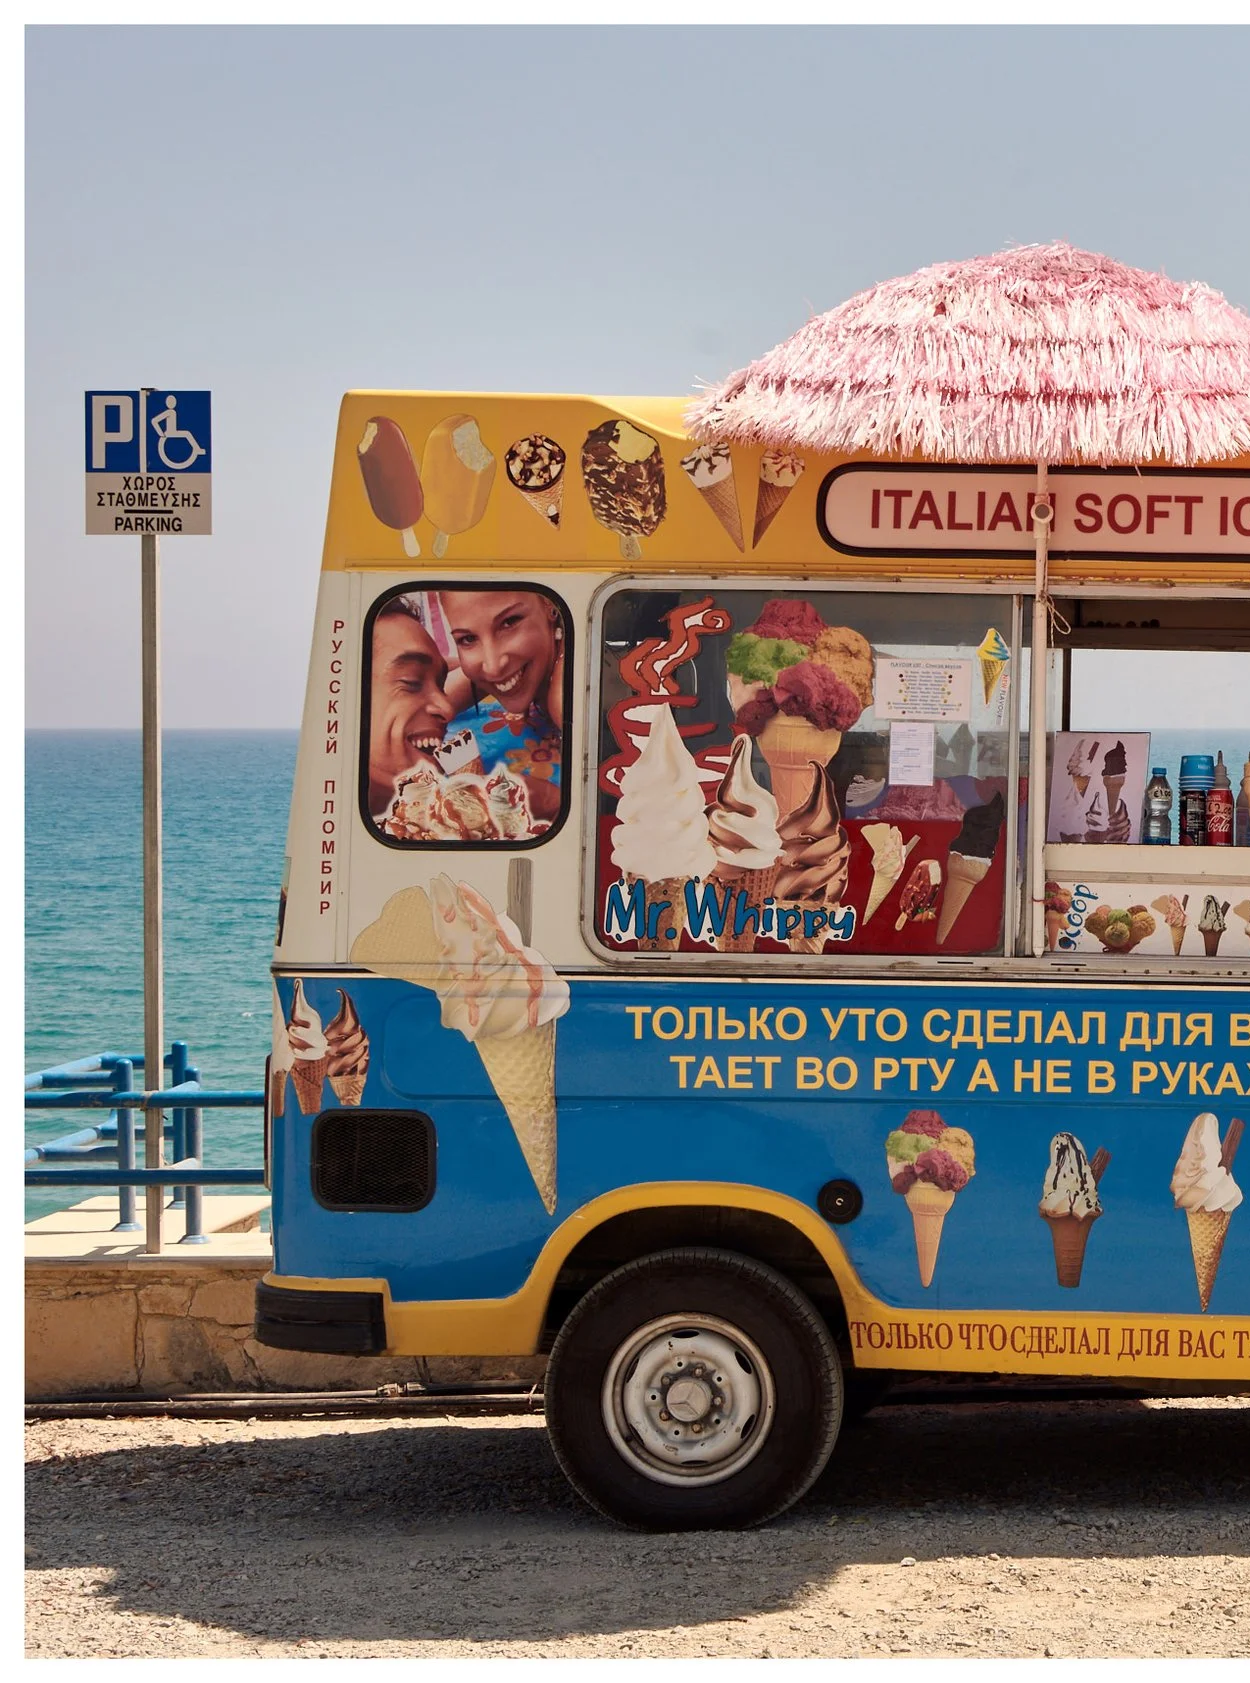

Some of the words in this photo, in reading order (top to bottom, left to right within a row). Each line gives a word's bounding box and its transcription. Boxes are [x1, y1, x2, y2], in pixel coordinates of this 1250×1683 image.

[92, 395, 133, 469] P
[96, 492, 201, 507] ΣΤΑΘΜΕΥΣΗΣ
[122, 476, 176, 491] ΧΩΡΟΣ
[114, 516, 183, 532] PARKING
[871, 489, 1056, 532] ITALIAN
[1074, 493, 1204, 535] SOFT
[324, 619, 345, 755] РУССКИЙ
[319, 779, 336, 916] ПЛОМБИР
[604, 878, 677, 940] Mr.
[684, 878, 854, 940] Whippy
[625, 1006, 808, 1041] ТОЛЬКО
[821, 1007, 908, 1042] УТО
[922, 1008, 1106, 1050] СДЕЛАЛ
[1119, 1011, 1213, 1052] ДЛЯ
[669, 1055, 782, 1089] ТАЕТ
[796, 1056, 859, 1090] ВО
[873, 1058, 956, 1092] РТУ
[966, 1059, 1000, 1092] А
[1013, 1060, 1072, 1093] НЕ
[1087, 1060, 1117, 1094] В
[850, 1321, 954, 1350] ТОЛЬКО
[1117, 1328, 1170, 1361] ДЛЯ
[1178, 1329, 1225, 1359] ВАС
